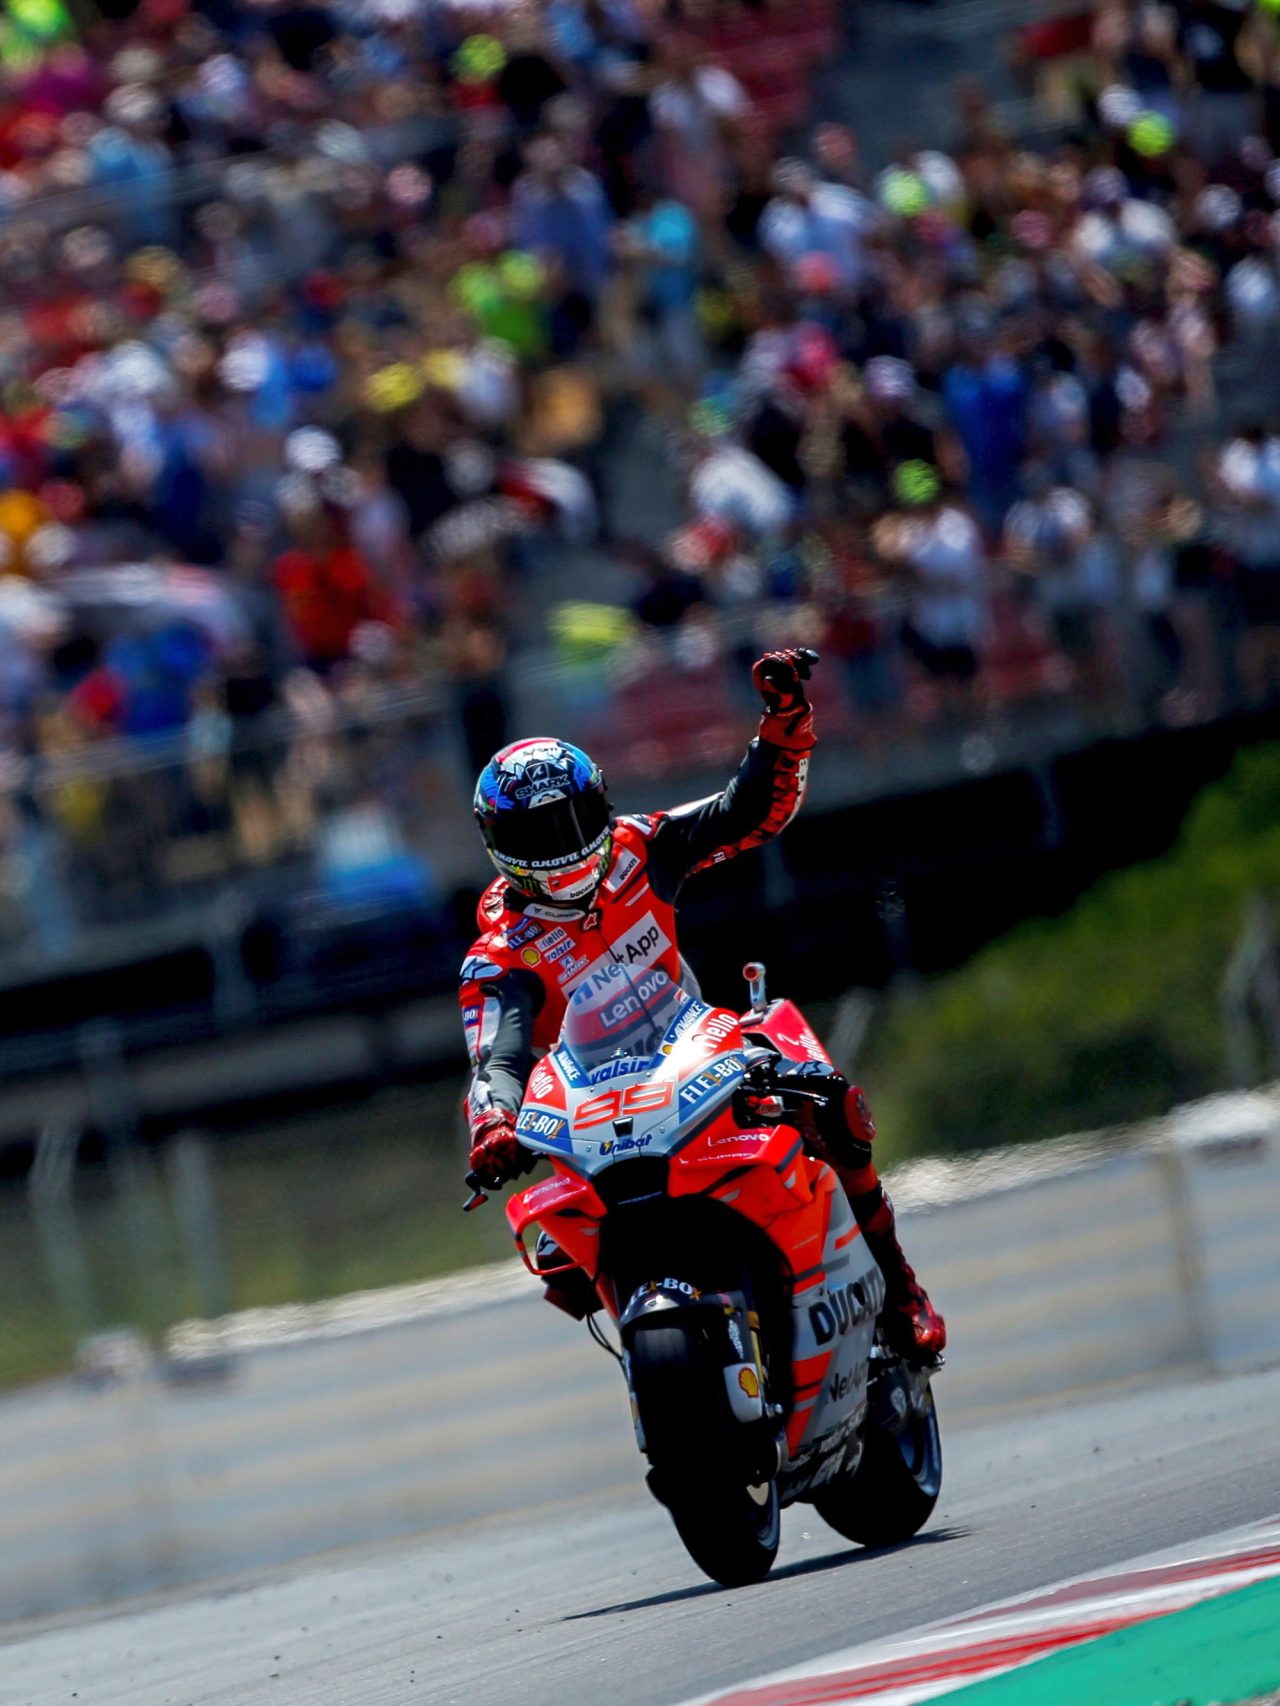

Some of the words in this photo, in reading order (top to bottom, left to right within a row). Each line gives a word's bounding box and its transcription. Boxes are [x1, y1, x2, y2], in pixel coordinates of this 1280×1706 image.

[515, 774, 570, 799] SHARK
[600, 971, 668, 1028] Lenovo
[591, 1058, 651, 1085] valsir
[572, 1080, 675, 1131] 99
[517, 1111, 566, 1140] LEX-BOX
[599, 1134, 653, 1155] Unibat
[708, 1133, 770, 1147] Lenovo
